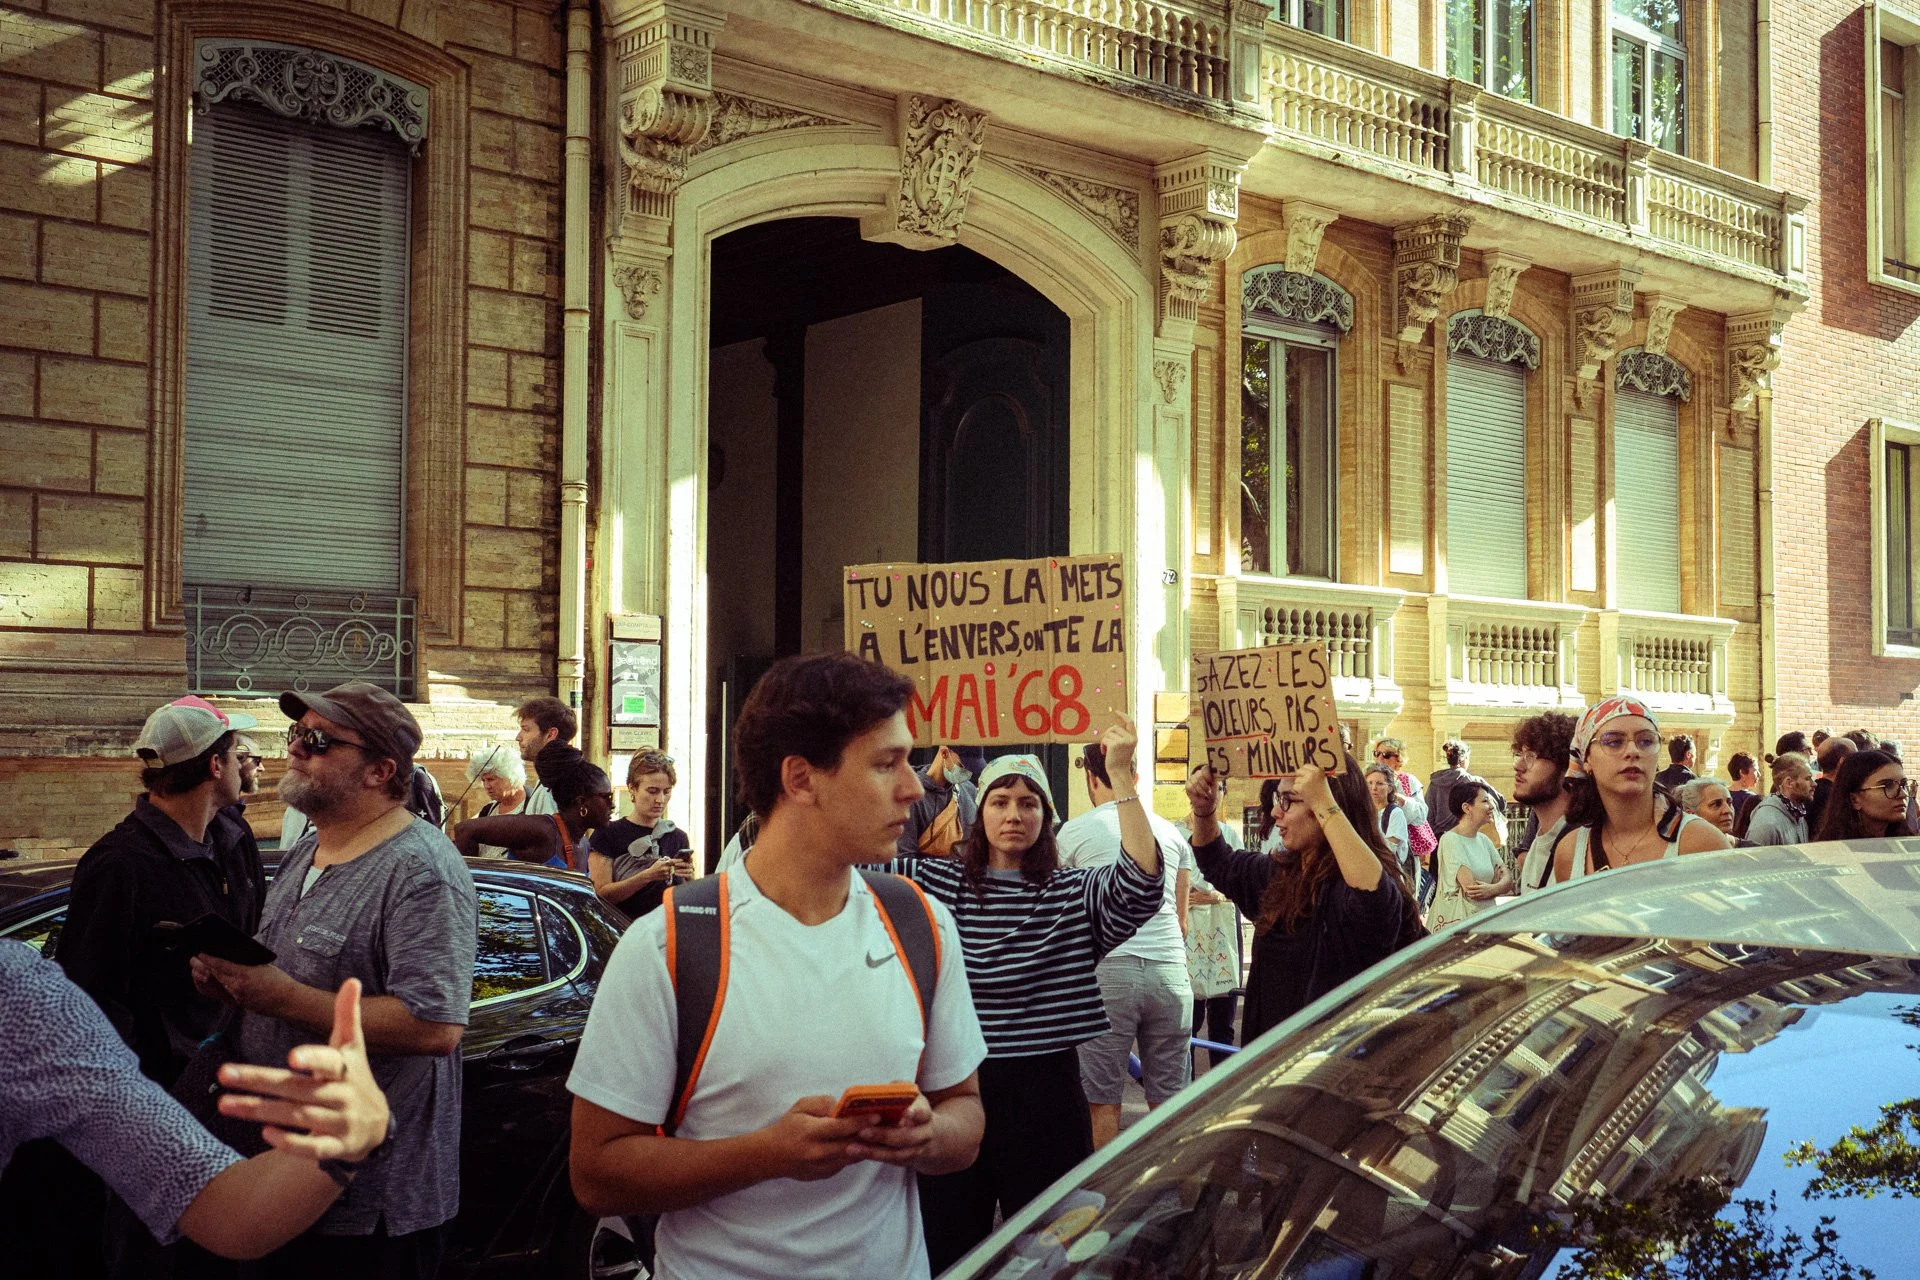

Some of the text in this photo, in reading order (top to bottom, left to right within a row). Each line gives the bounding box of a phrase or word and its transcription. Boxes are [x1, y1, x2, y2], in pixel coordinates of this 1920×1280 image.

[847, 563, 1123, 611] TU NOUS LA METS
[899, 620, 1022, 665] L'ENVERS,
[1043, 616, 1084, 653] TE
[1092, 618, 1124, 653] LA
[1276, 649, 1327, 688] LES
[1201, 694, 1320, 739] IOLEURS, PAS
[1207, 746, 1231, 775] ES
